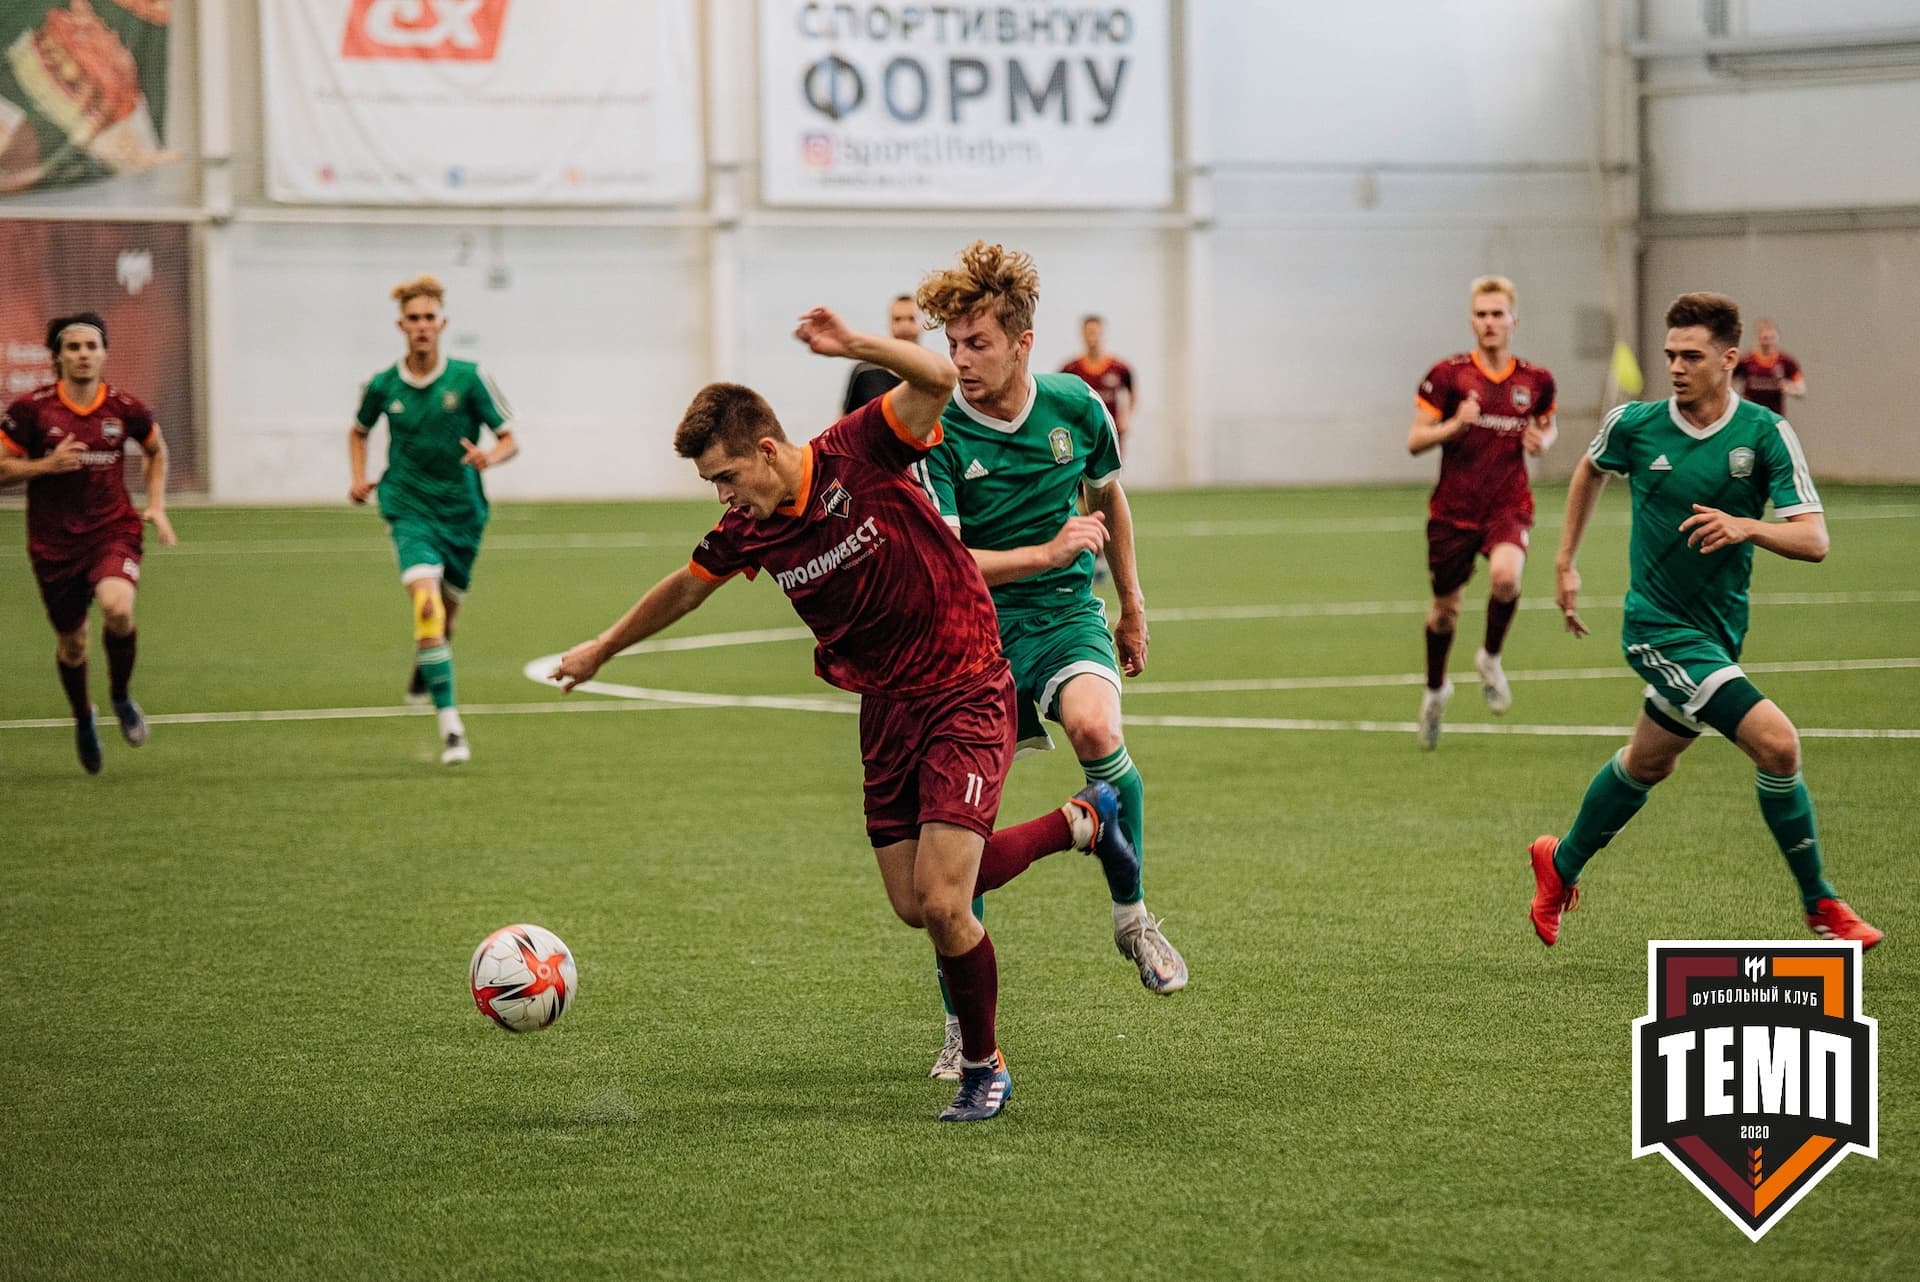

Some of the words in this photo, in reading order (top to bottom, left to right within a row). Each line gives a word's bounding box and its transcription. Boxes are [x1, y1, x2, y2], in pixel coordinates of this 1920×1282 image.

[798, 4, 1132, 45] СПОРТИВНУЮ
[803, 54, 1131, 123] ФОРМУ
[776, 516, 878, 589] ПРОДИНВЕСТ
[964, 772, 983, 807] 11
